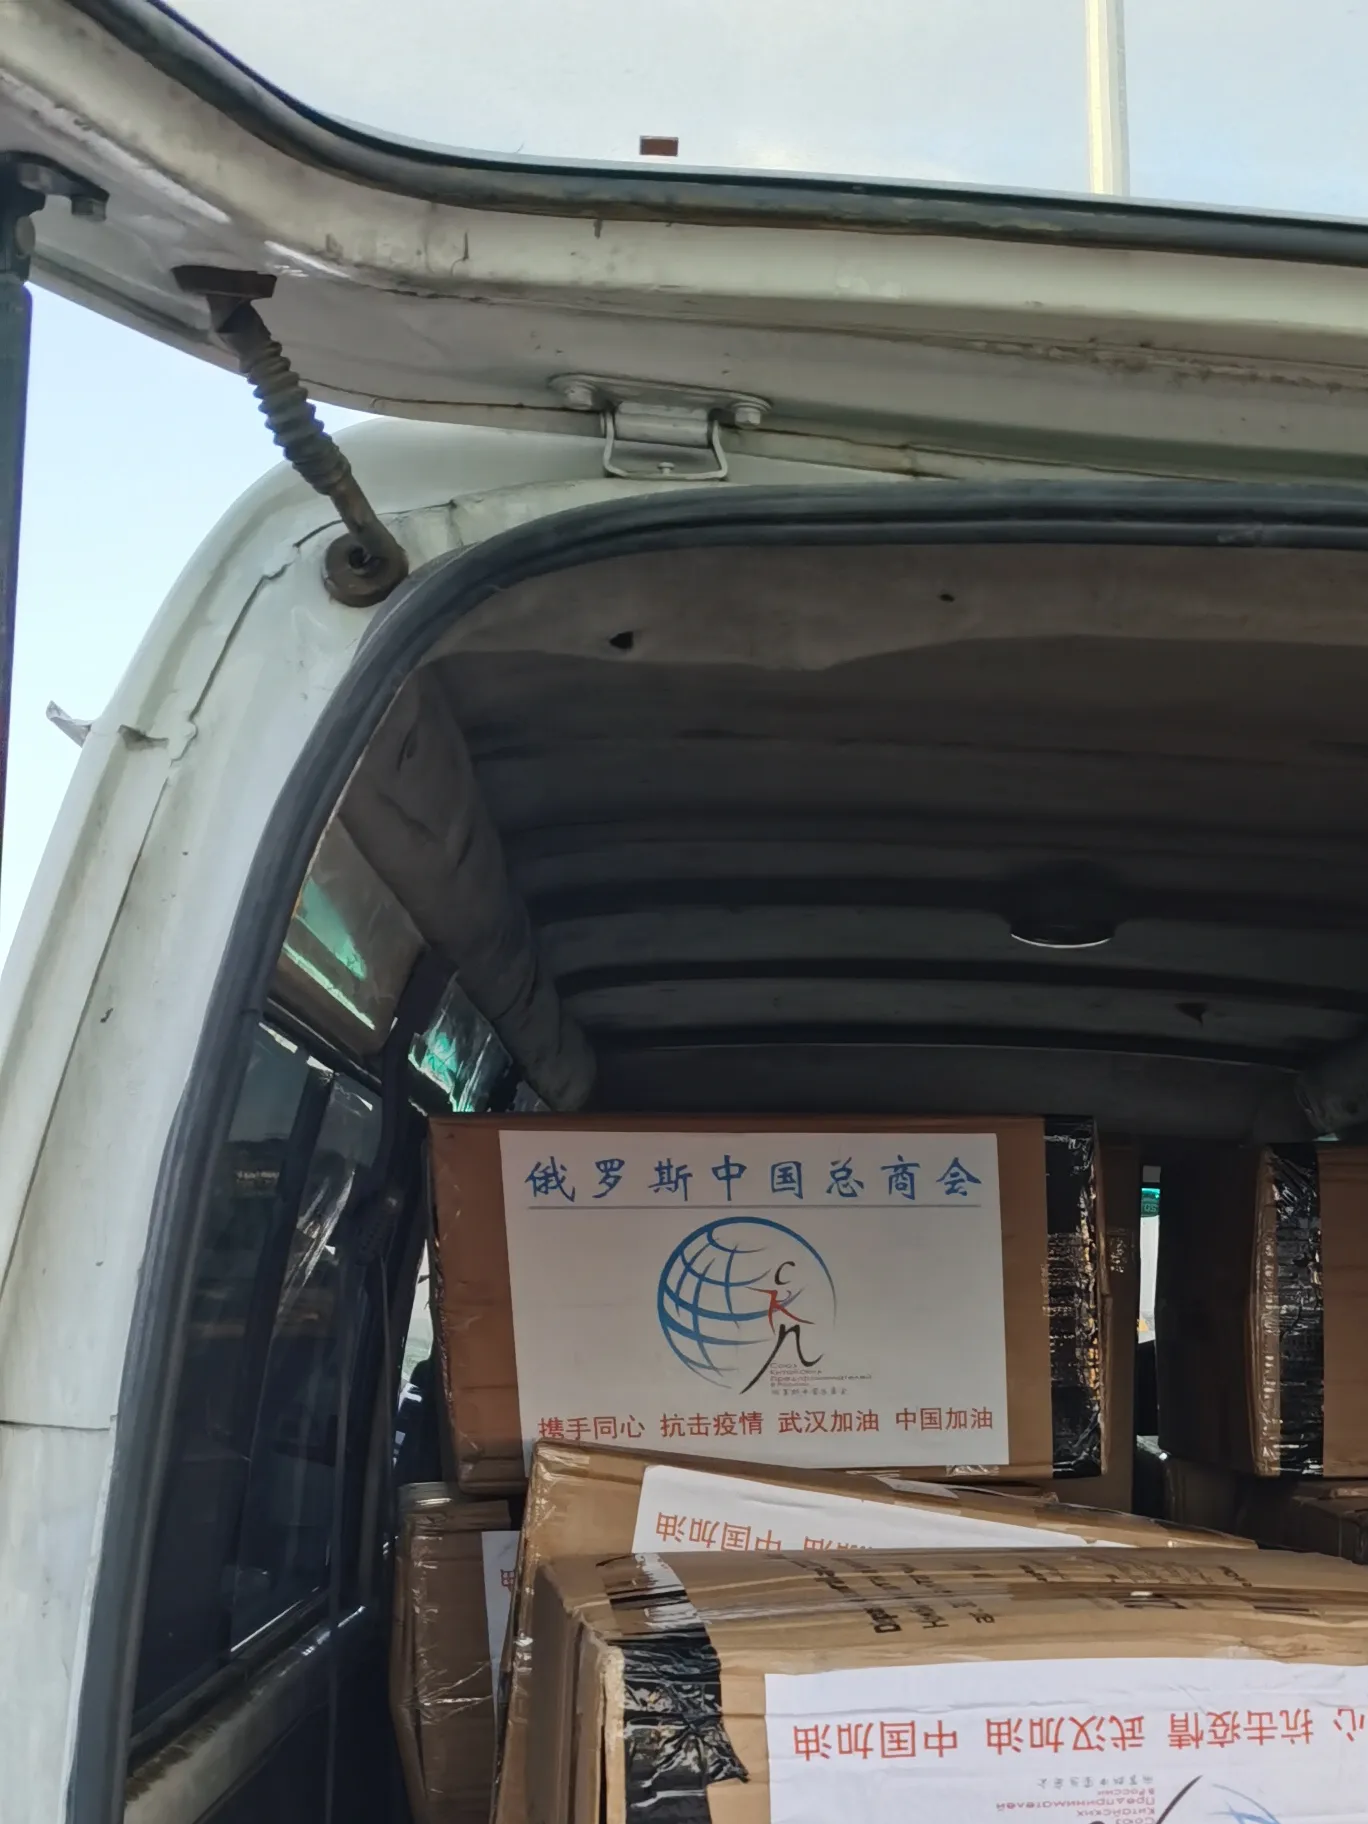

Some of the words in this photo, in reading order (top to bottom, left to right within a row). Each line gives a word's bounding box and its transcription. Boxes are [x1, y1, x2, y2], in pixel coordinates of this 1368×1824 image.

[525, 1154, 982, 1201] 俄罗斯中国总商会
[537, 1416, 645, 1444] 携手同心
[660, 1411, 764, 1438] 抗击疫情
[778, 1409, 880, 1434] 武汉加油
[895, 1407, 993, 1431] 中国加油
[793, 1721, 958, 1761] 中国加油
[985, 1715, 1143, 1754] 武汉加油
[1168, 1709, 1312, 1750] 抗击疫情
